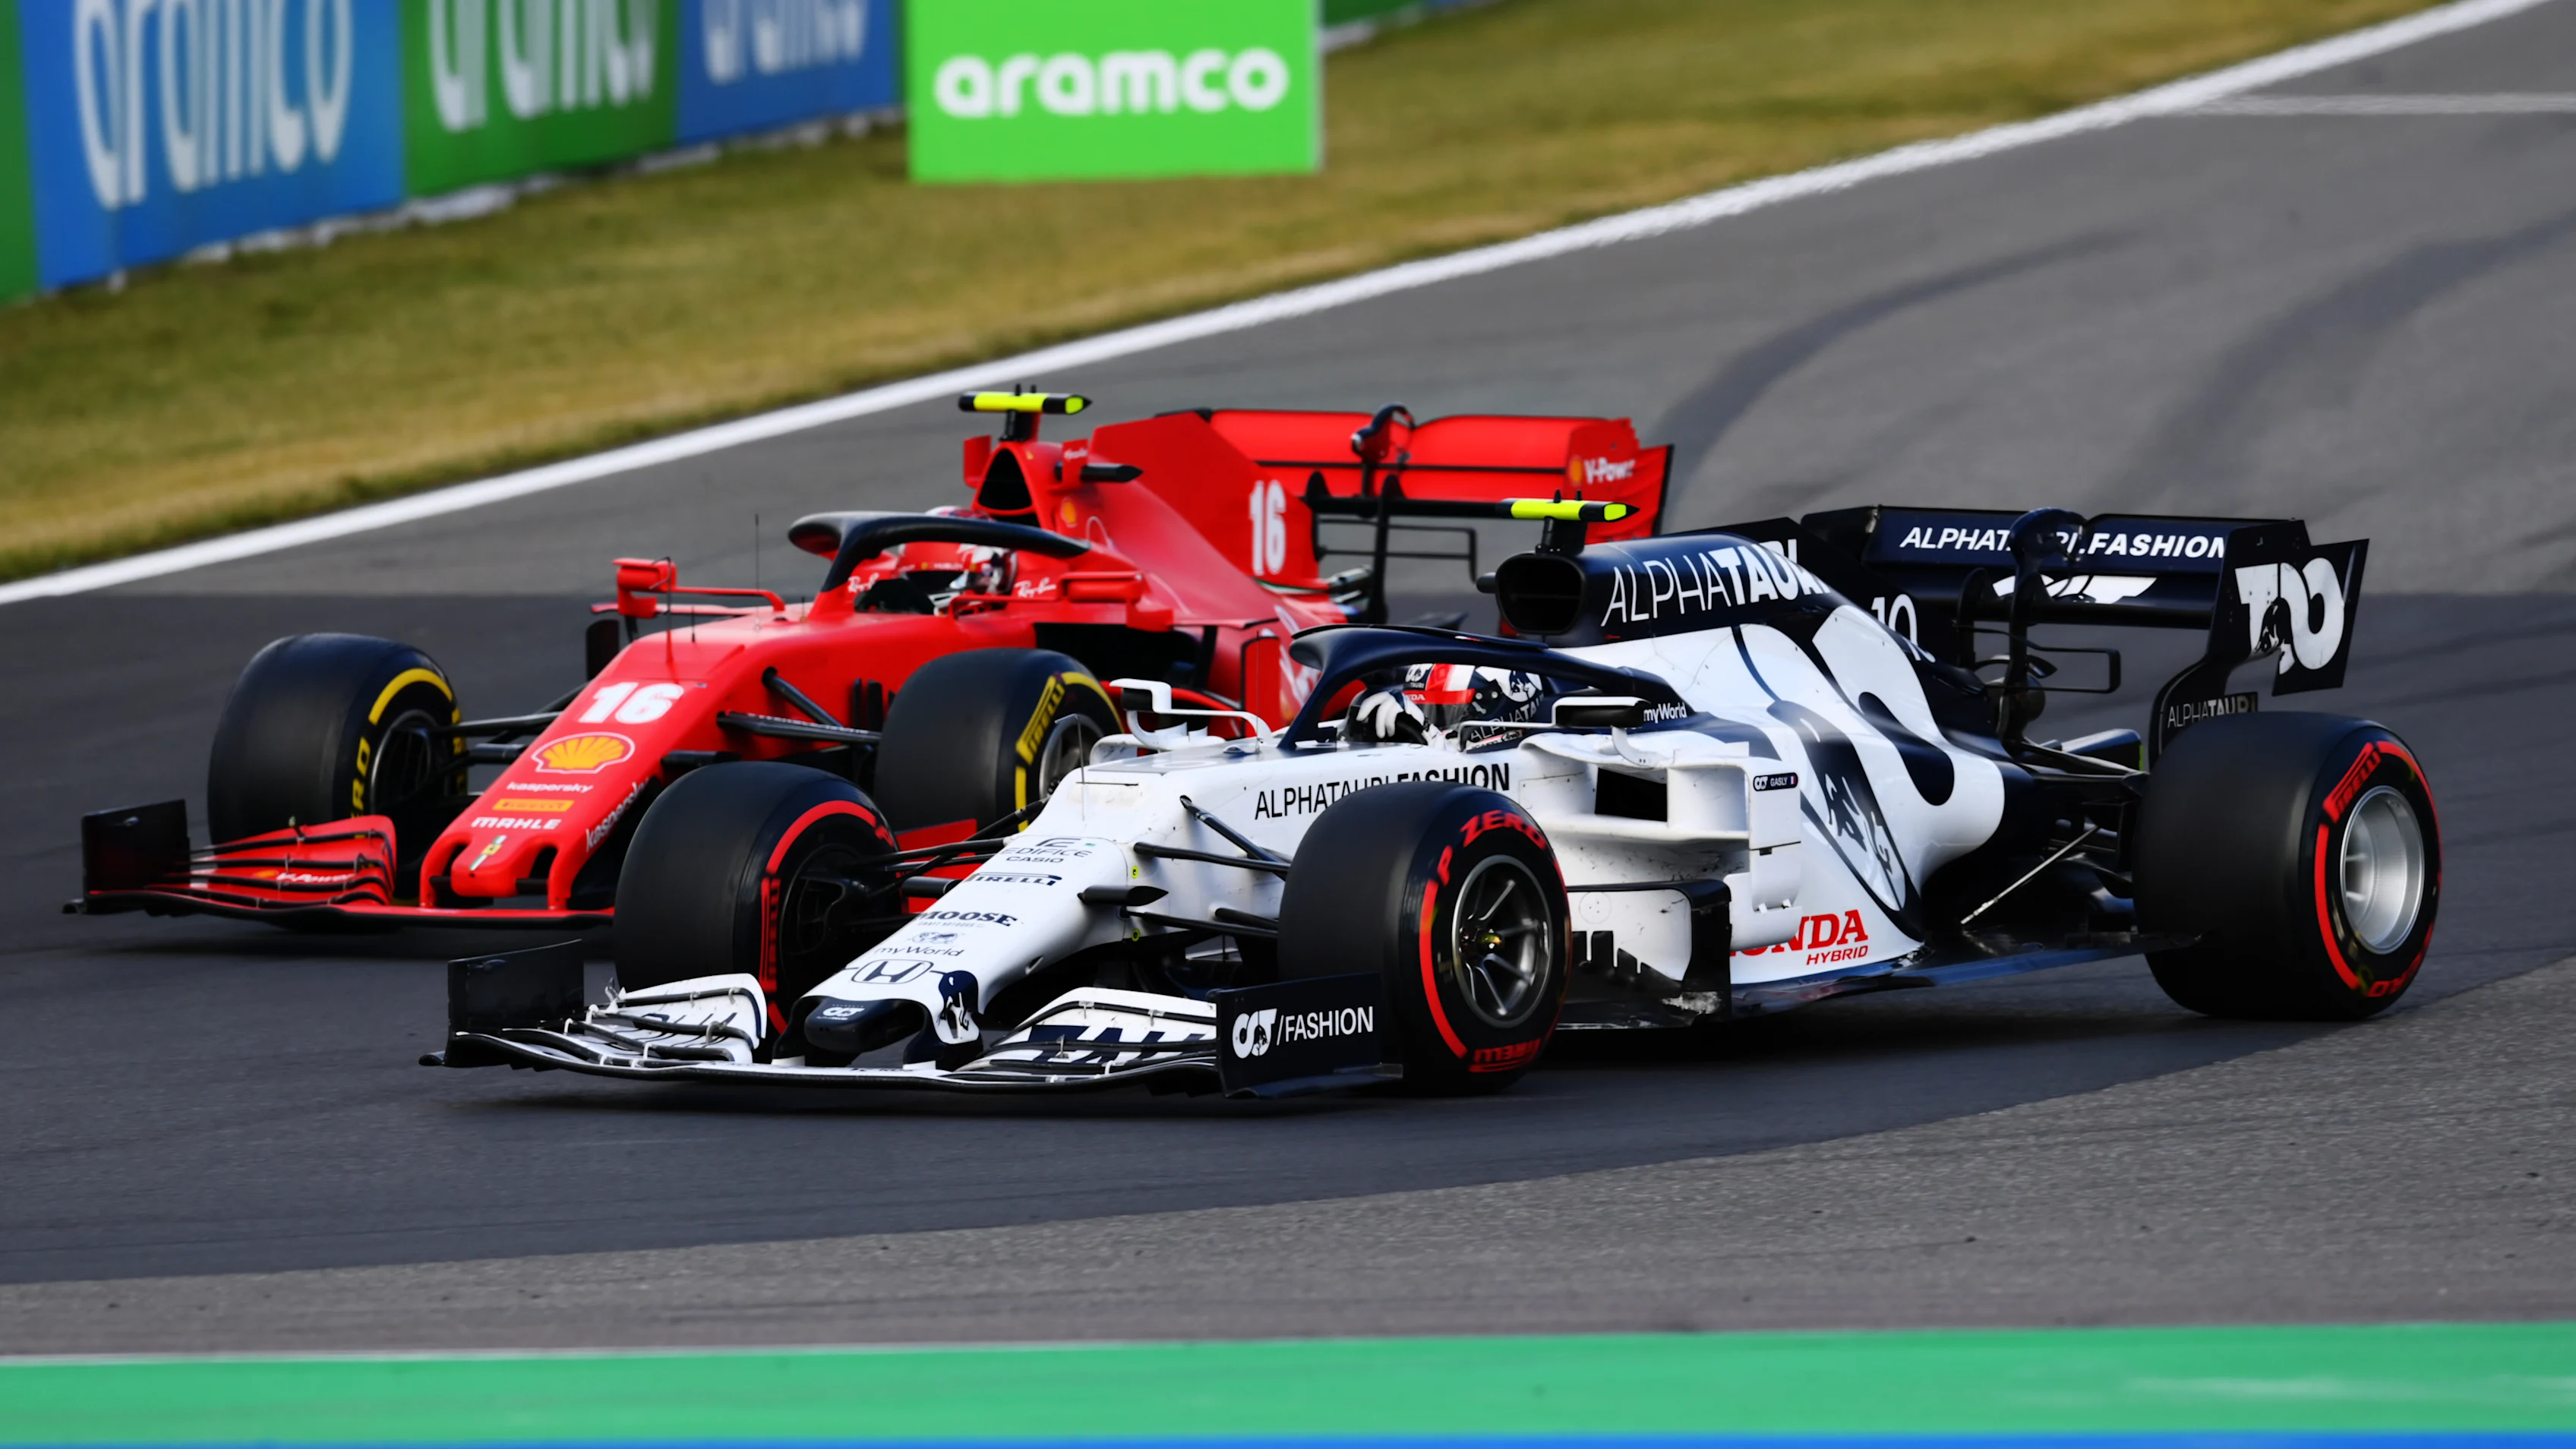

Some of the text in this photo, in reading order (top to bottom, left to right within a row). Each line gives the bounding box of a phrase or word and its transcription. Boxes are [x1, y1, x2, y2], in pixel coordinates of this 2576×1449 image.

[933, 49, 1290, 118] aramco
[1249, 478, 1286, 576] 16
[1870, 593, 1936, 663] 10
[579, 681, 684, 724] 16
[1643, 702, 1687, 724] myWorld
[507, 781, 594, 793] kaspersky
[1770, 777, 1788, 787] GASLY
[2322, 741, 2382, 824] PIRELLI
[471, 816, 562, 830] MAHLE
[1460, 810, 1547, 851] ZERO
[1002, 847, 1093, 857] EDIFICE
[1730, 909, 1868, 957] NDA
[1806, 945, 1869, 966] HYBRID
